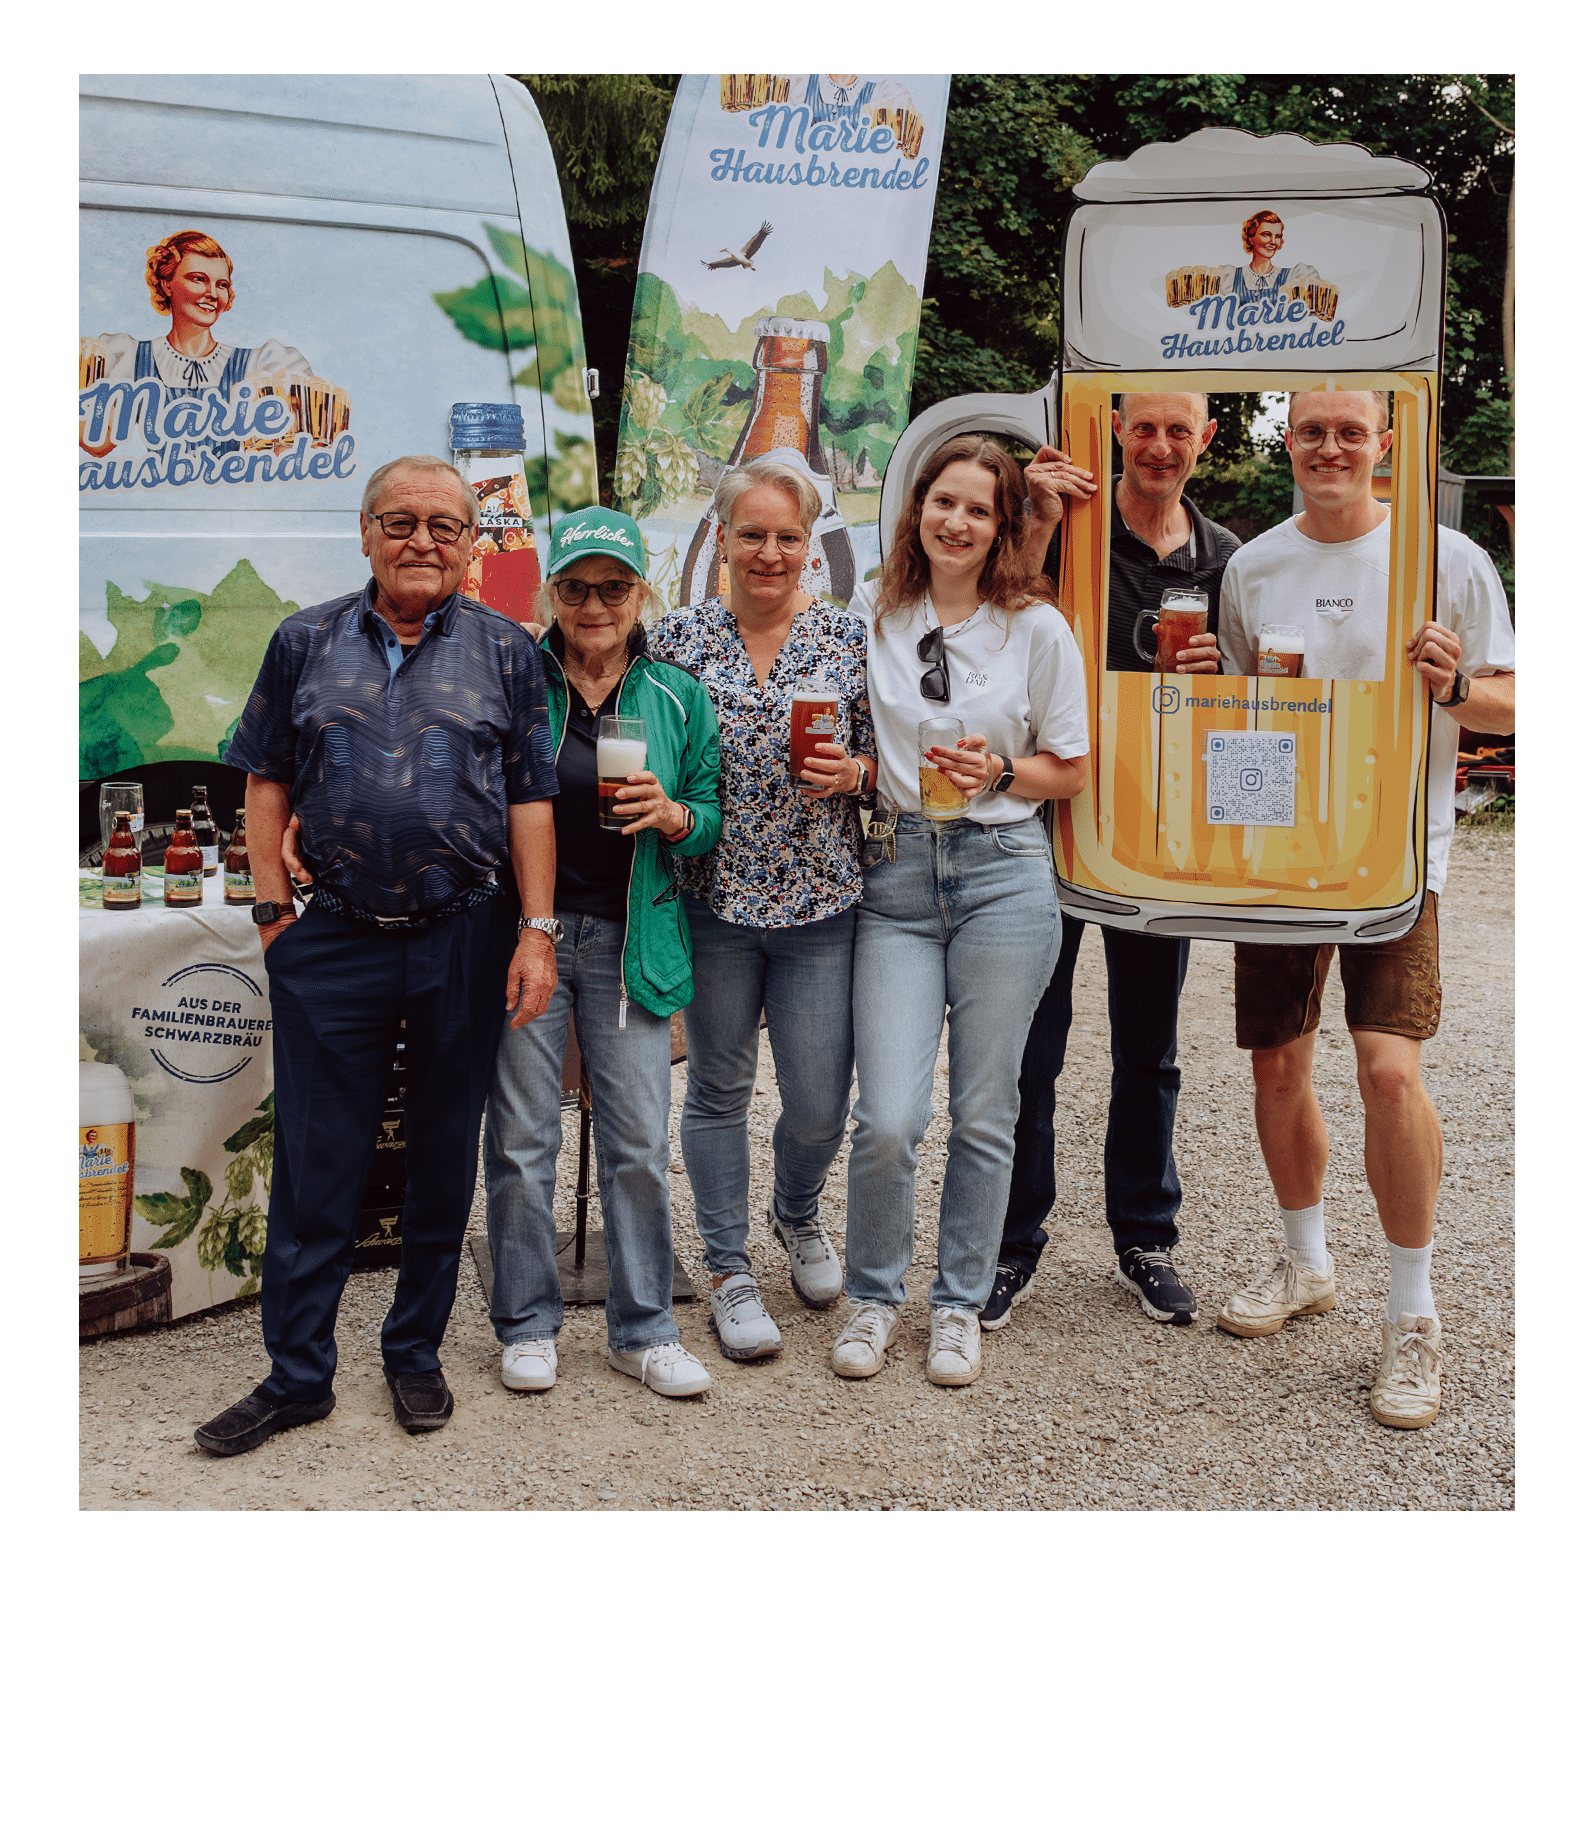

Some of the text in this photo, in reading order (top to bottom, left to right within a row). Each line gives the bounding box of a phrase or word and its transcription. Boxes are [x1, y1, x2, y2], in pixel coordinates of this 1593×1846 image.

[749, 105, 896, 154] Marie
[709, 148, 930, 190] Hausbrendel
[1190, 295, 1308, 330] Marie
[1160, 319, 1346, 359] Hausbrendel
[79, 382, 290, 444] Marie
[79, 434, 356, 491] ausbrendel
[480, 518, 520, 526] LASKA
[560, 522, 634, 549] Herrlicher
[1315, 598, 1354, 608] BIANCO
[1186, 695, 1333, 713] mariehausbrendel
[178, 997, 241, 1013] AUS DER
[145, 1026, 263, 1047] SCHWARZBRÄU
[354, 1232, 402, 1249] Schwarz
